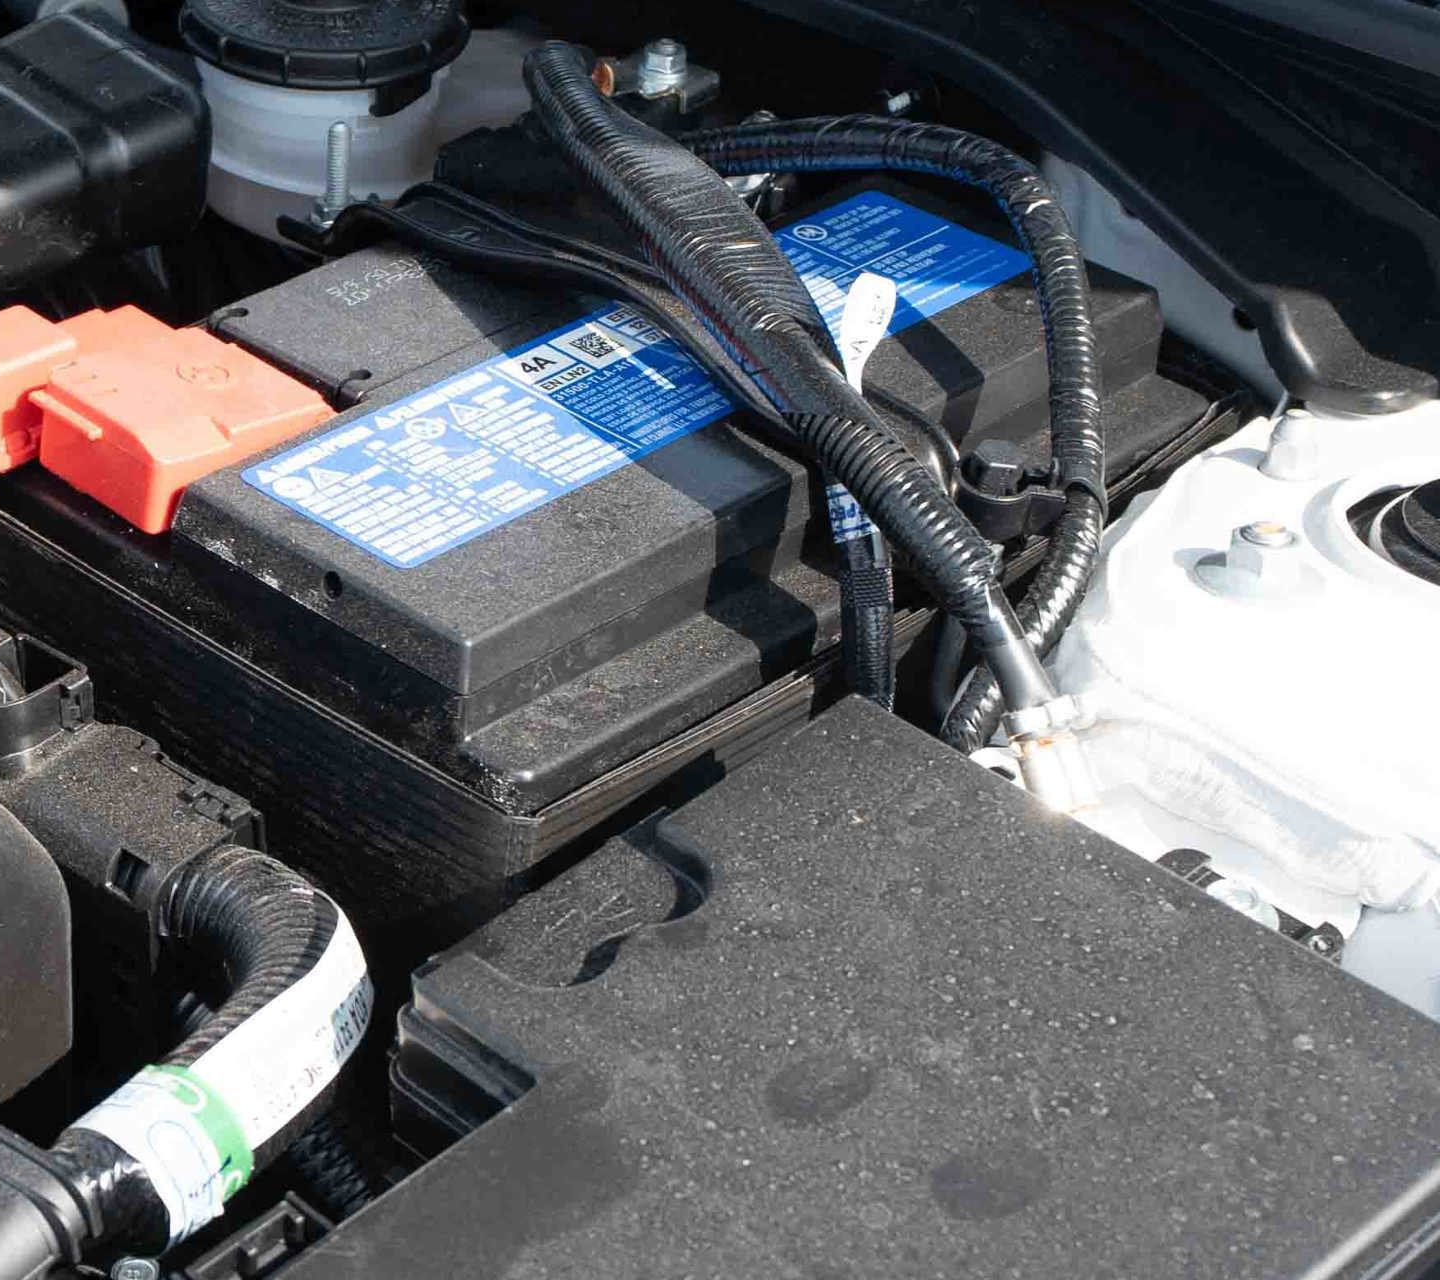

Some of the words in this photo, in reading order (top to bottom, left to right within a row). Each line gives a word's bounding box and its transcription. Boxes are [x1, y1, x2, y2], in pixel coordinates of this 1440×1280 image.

[521, 355, 557, 376] 4A
[540, 379, 562, 392] EN
[563, 365, 591, 382] LN2
